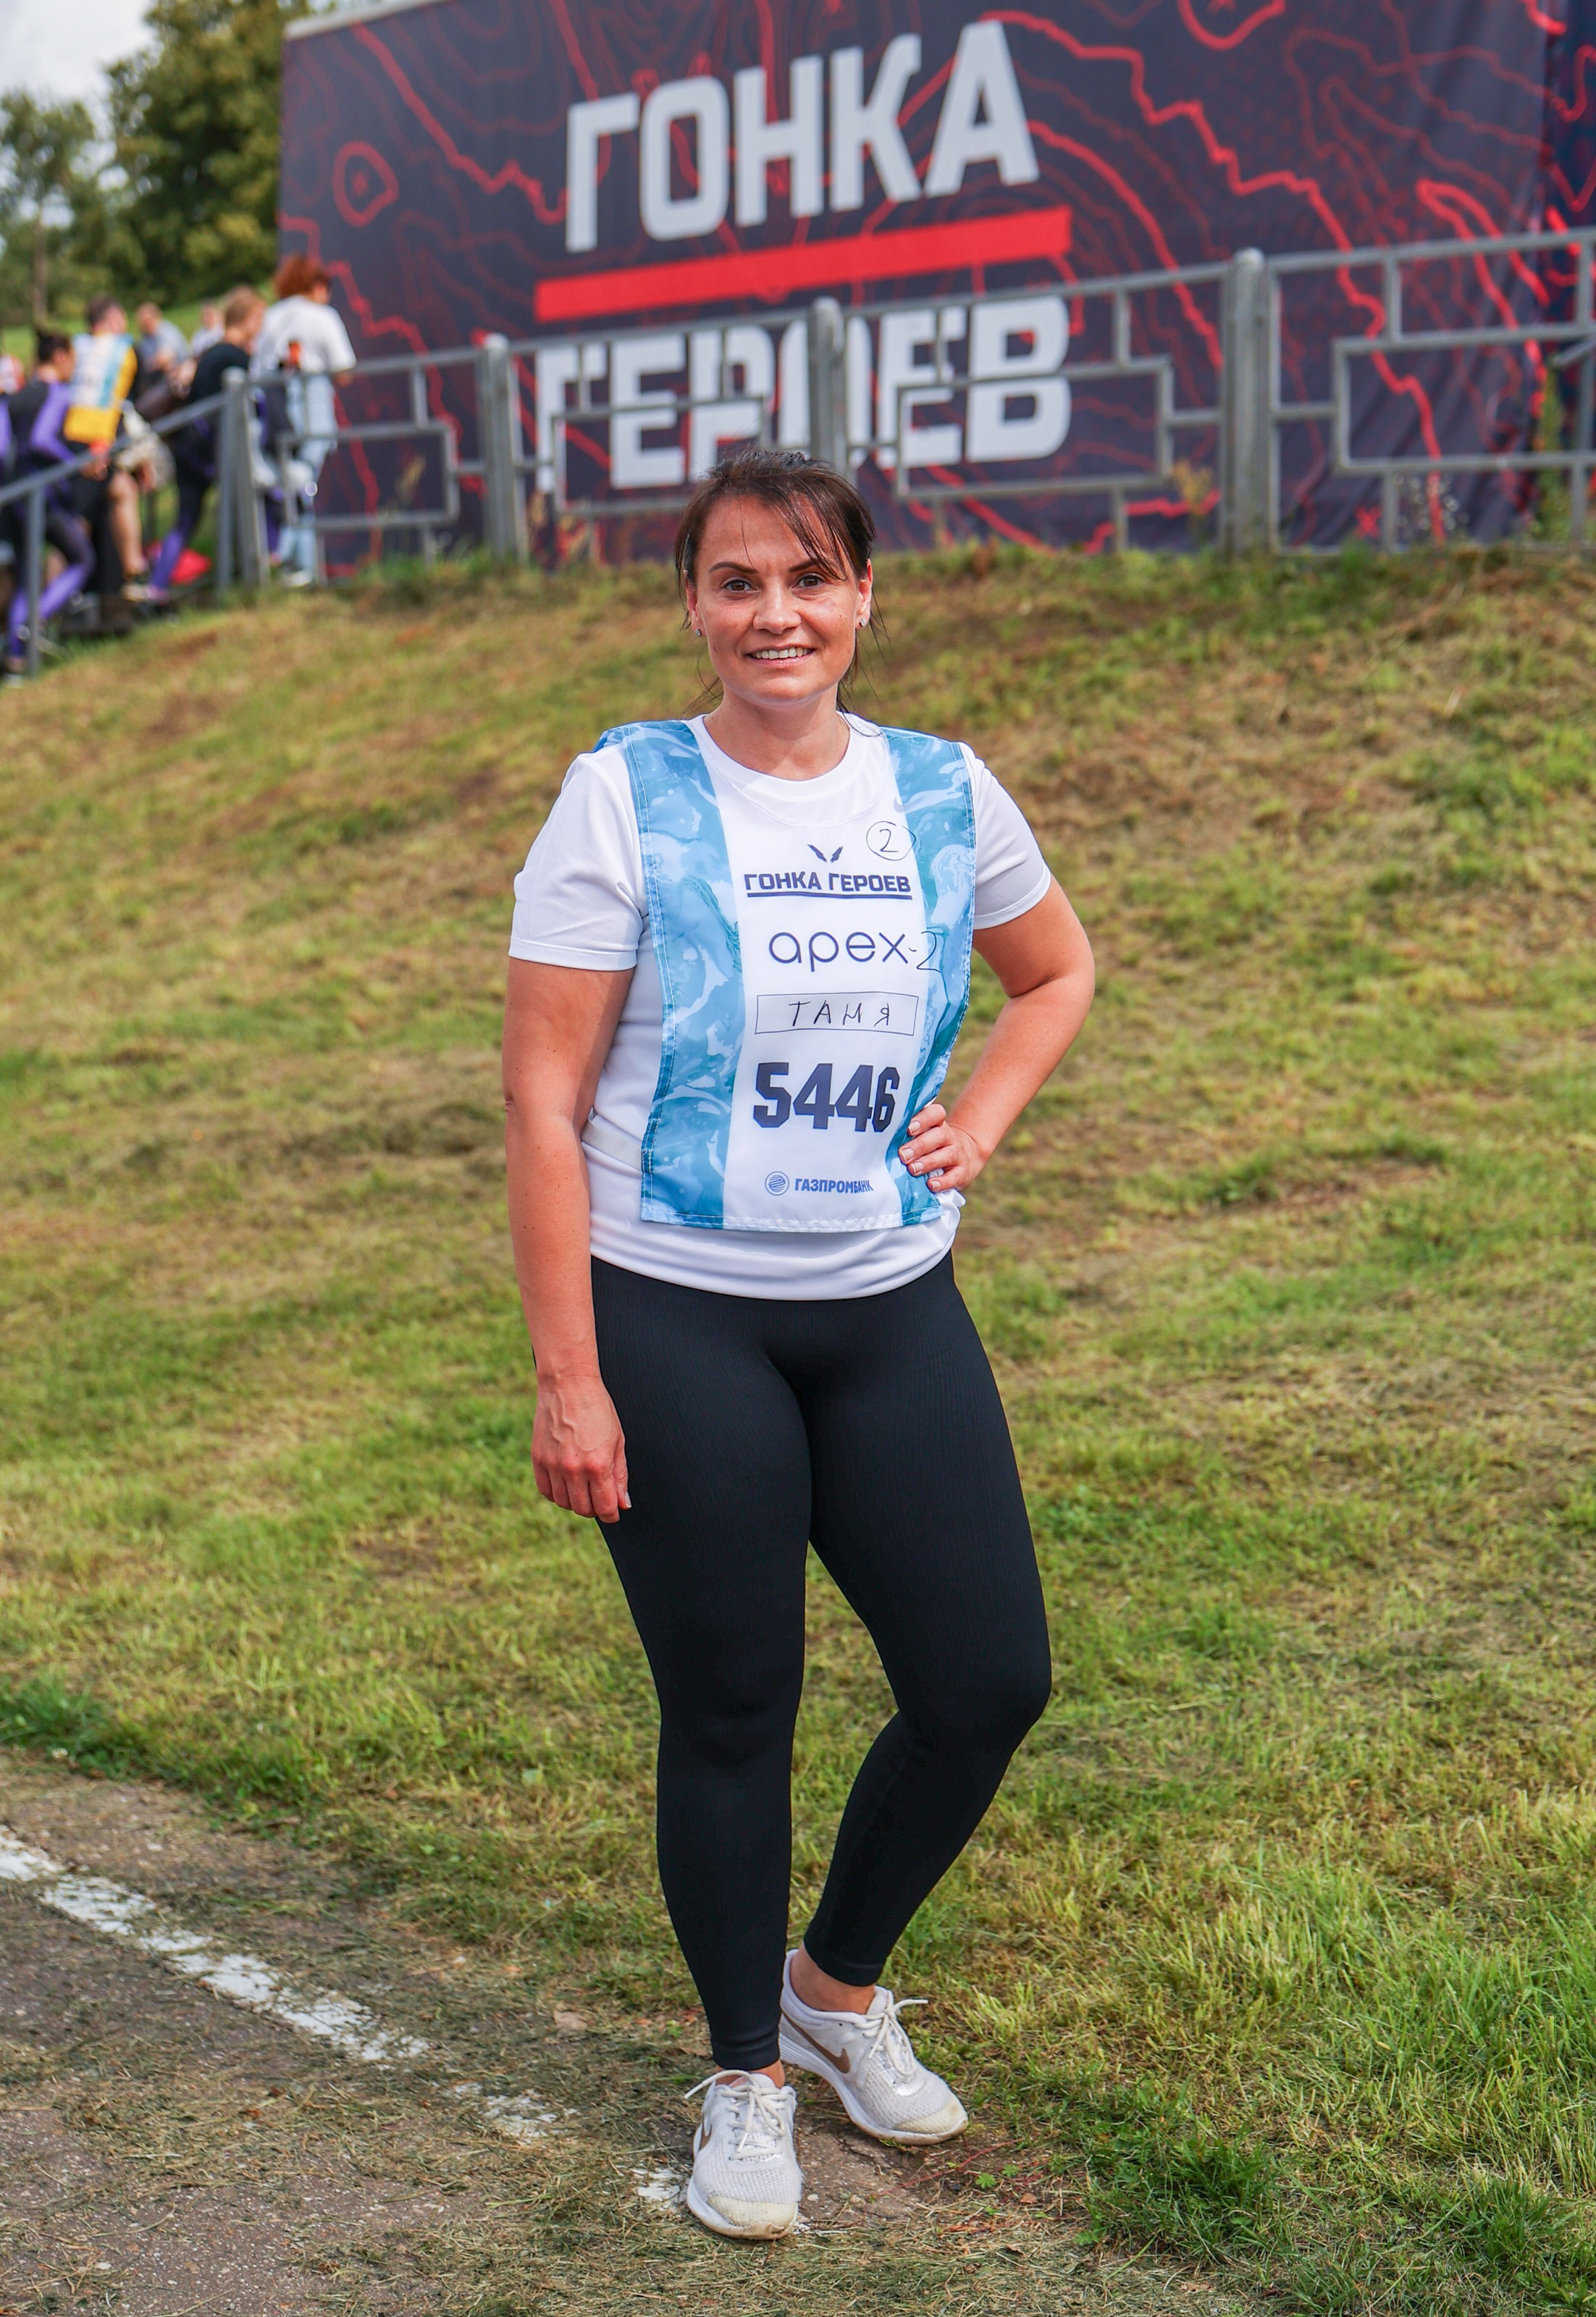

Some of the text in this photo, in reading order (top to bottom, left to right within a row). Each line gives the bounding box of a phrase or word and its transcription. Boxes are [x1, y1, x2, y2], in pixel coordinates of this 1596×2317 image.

[566, 20, 1040, 253] ГОНКА
[536, 295, 1072, 493] ГЕРОЕВ
[879, 828, 899, 853] 2
[744, 871, 911, 892] ГОНКА ГЕРОЕВ
[769, 931, 908, 972] apex
[753, 1061, 901, 1132] 5446
[794, 1178, 874, 1194] ГАЗПРОМБАНК
